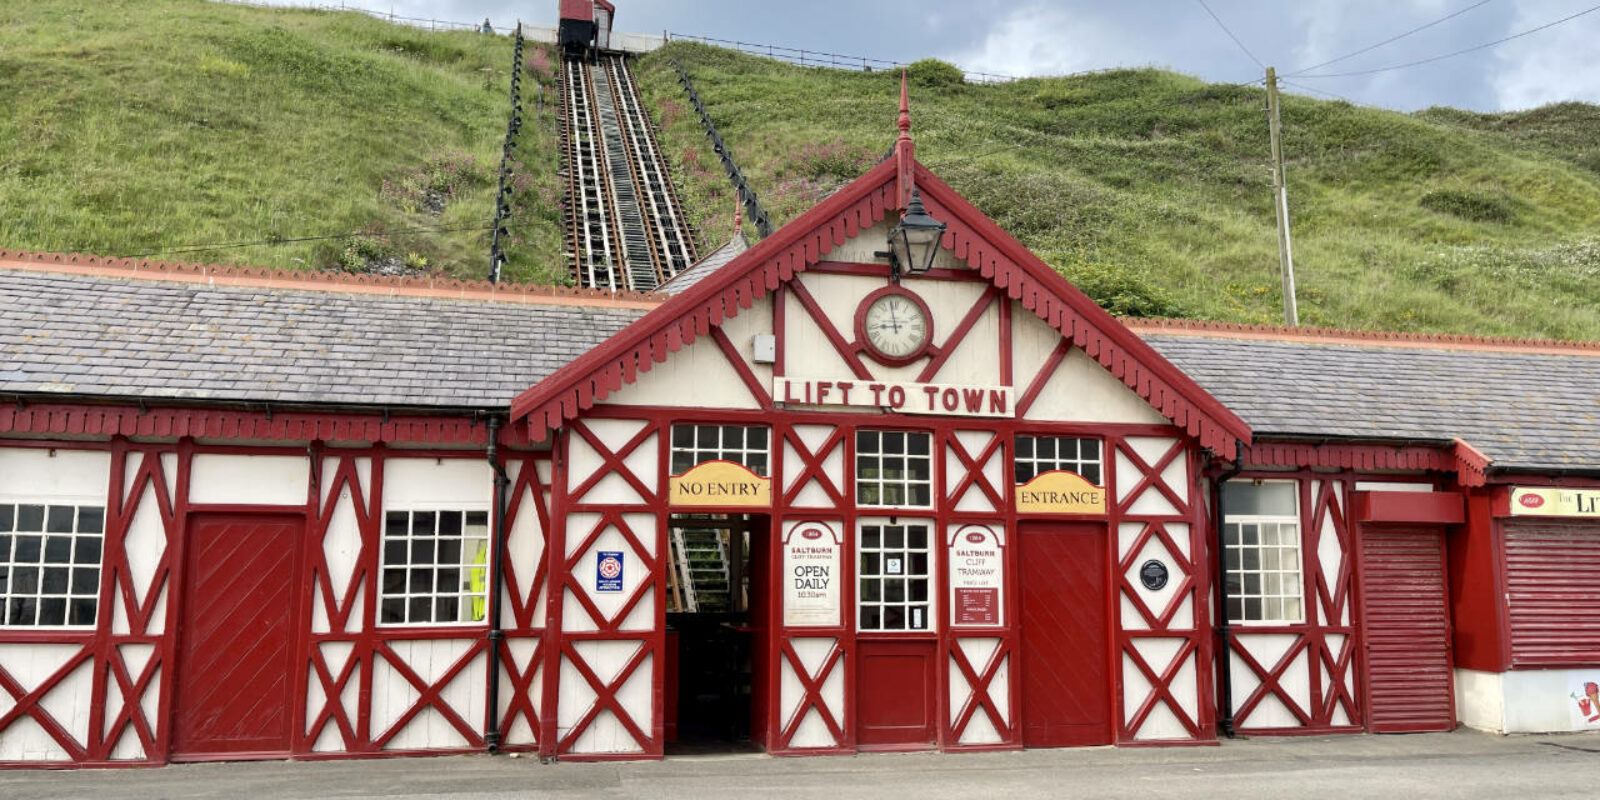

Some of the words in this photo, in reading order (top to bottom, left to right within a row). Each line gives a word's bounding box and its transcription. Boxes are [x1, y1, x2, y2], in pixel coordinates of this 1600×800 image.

[785, 381, 853, 406] LIFT
[870, 384, 905, 409] TO
[923, 386, 1006, 413] TOWN
[679, 482, 703, 495] NO
[708, 482, 760, 496] ENTRY
[1021, 491, 1099, 505] ENTRANCE
[965, 558, 985, 566] CLIFF
[794, 565, 829, 577] OPEN
[957, 568, 995, 576] TRAMWAY
[794, 578, 830, 589] DAILY
